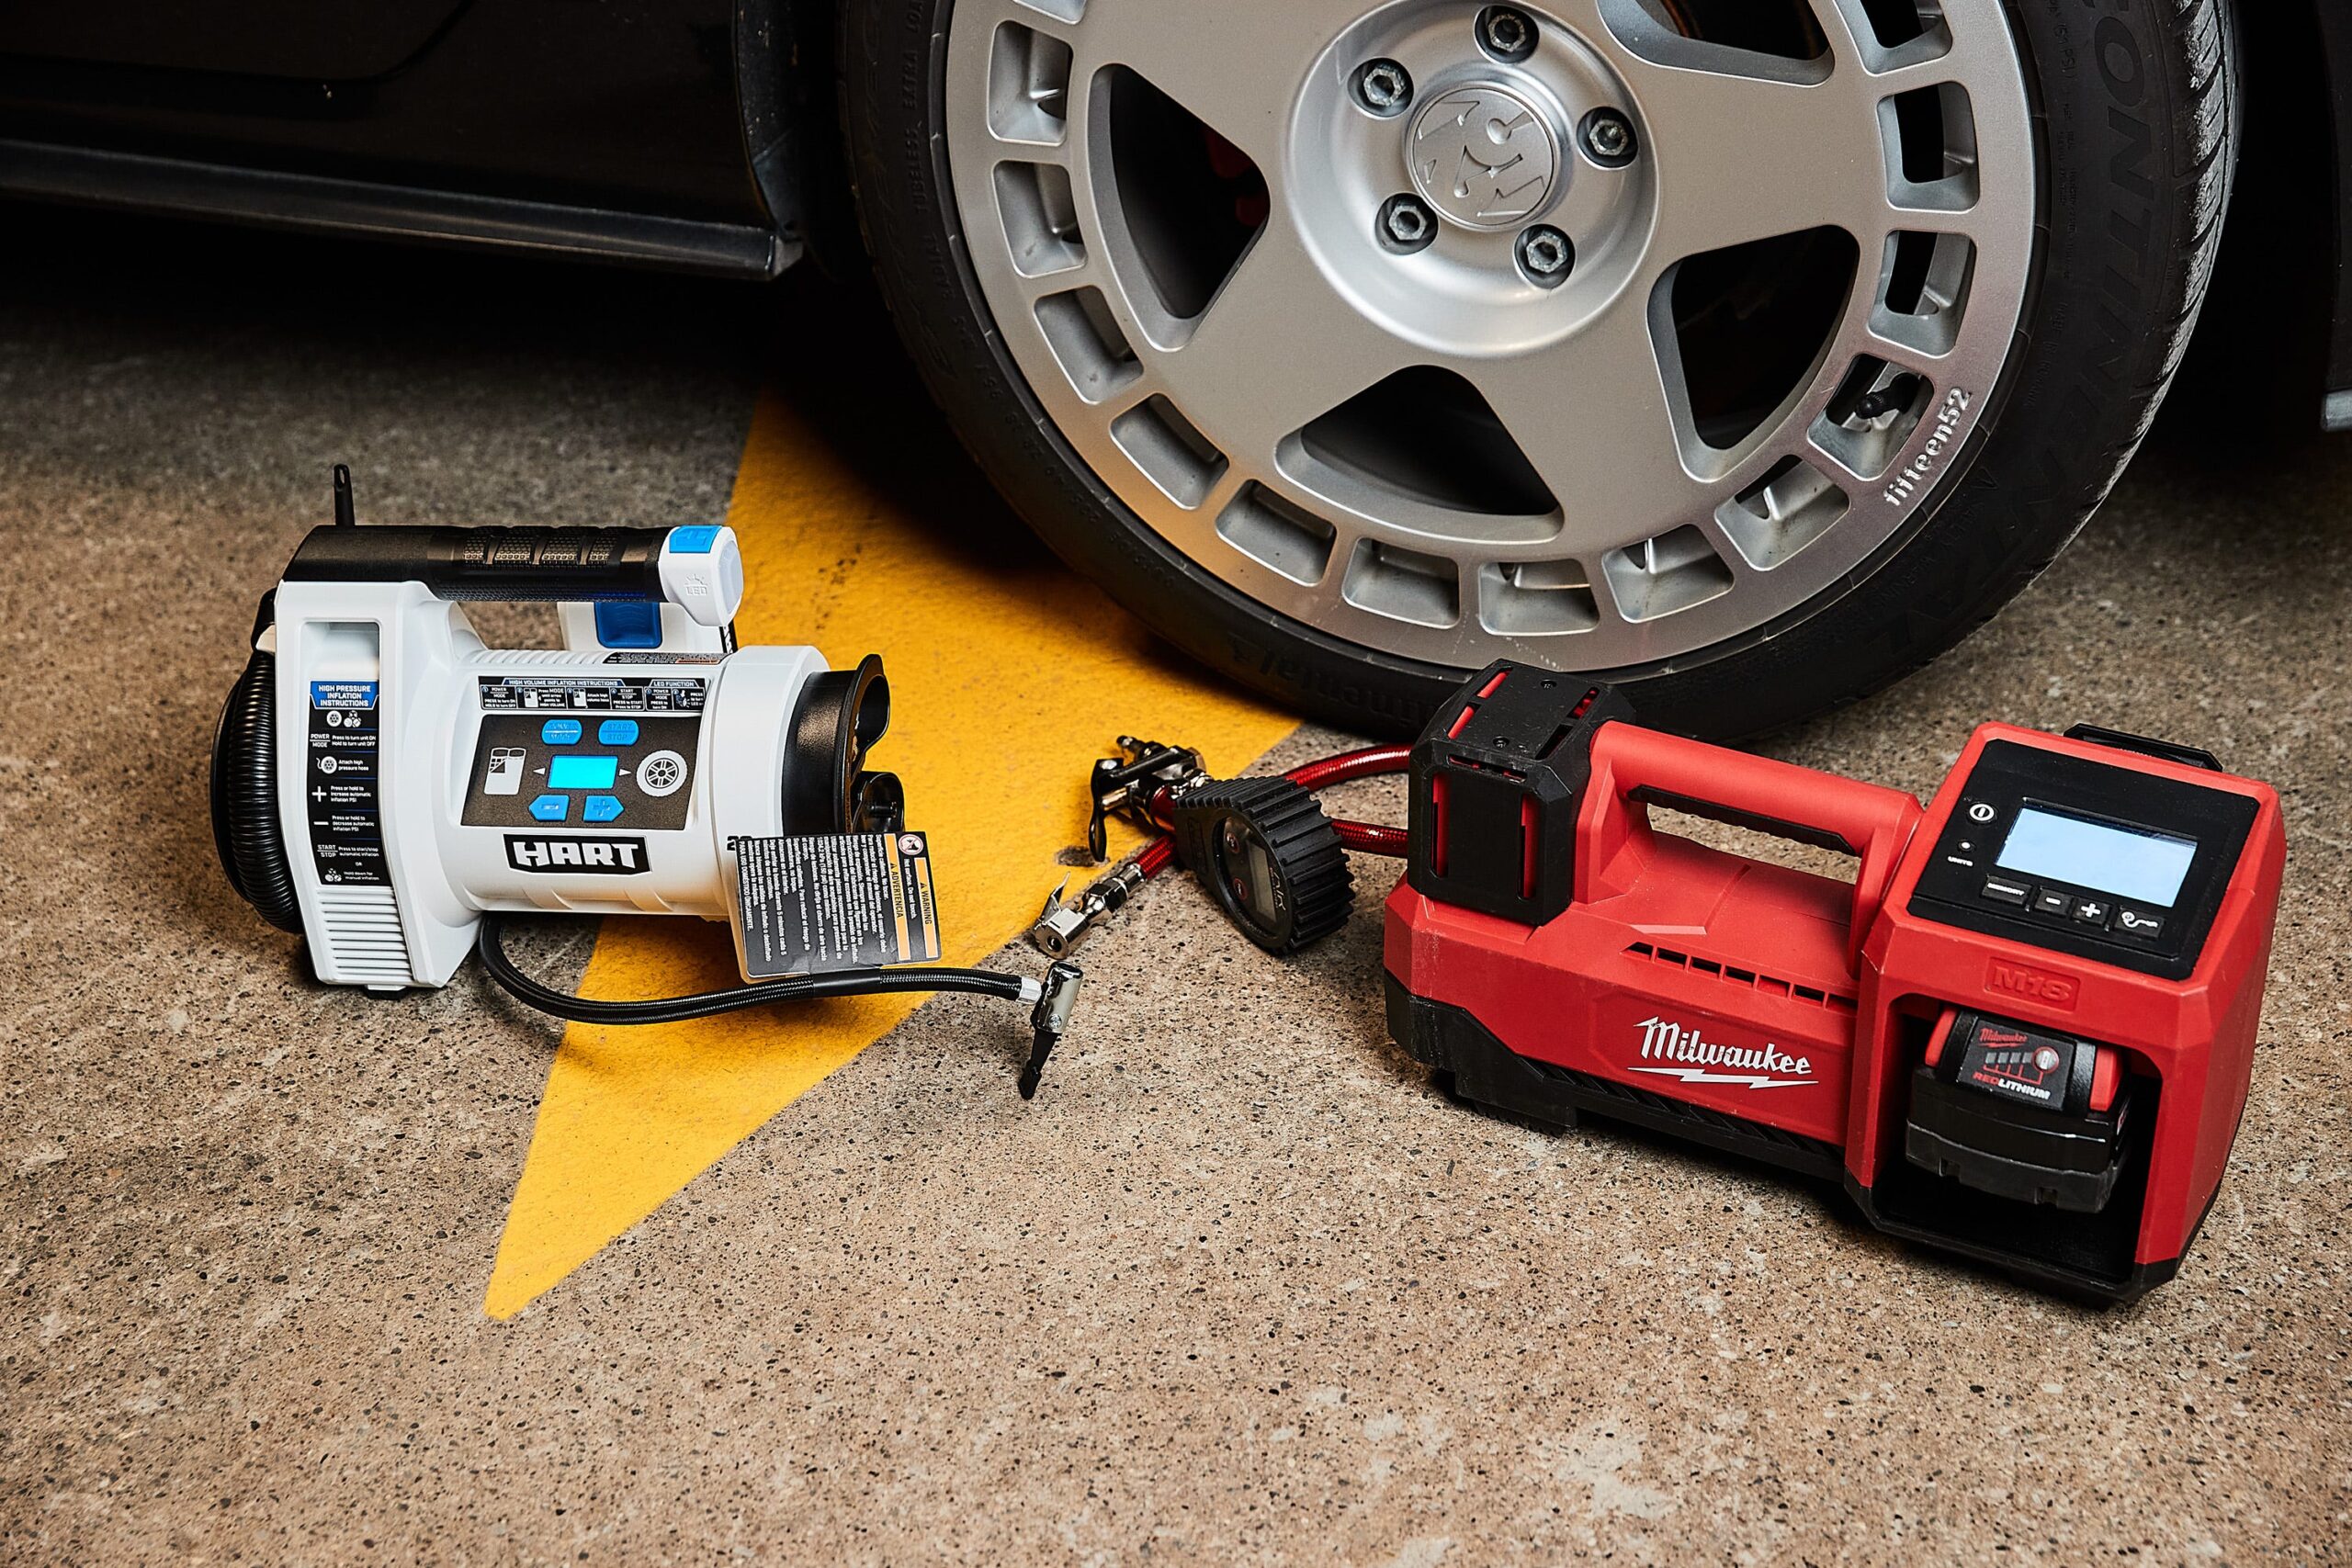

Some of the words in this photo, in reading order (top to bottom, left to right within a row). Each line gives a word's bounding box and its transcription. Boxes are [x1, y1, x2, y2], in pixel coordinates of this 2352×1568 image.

[1883, 386, 1973, 506] fifteen52
[685, 586, 707, 596] LED
[607, 722, 632, 731] START
[513, 842, 639, 869] HART
[1947, 855, 1973, 866] UNITS
[890, 871, 903, 918] ADVERTENCIA
[1987, 882, 2025, 897] MEMORY
[921, 890, 932, 924] WARNING
[1992, 966, 2073, 1001] M18
[1633, 1016, 1812, 1075] Milwaukee
[1978, 1027, 2028, 1044] Milwaukee
[1973, 1071, 2051, 1100] REDLITHIUM
